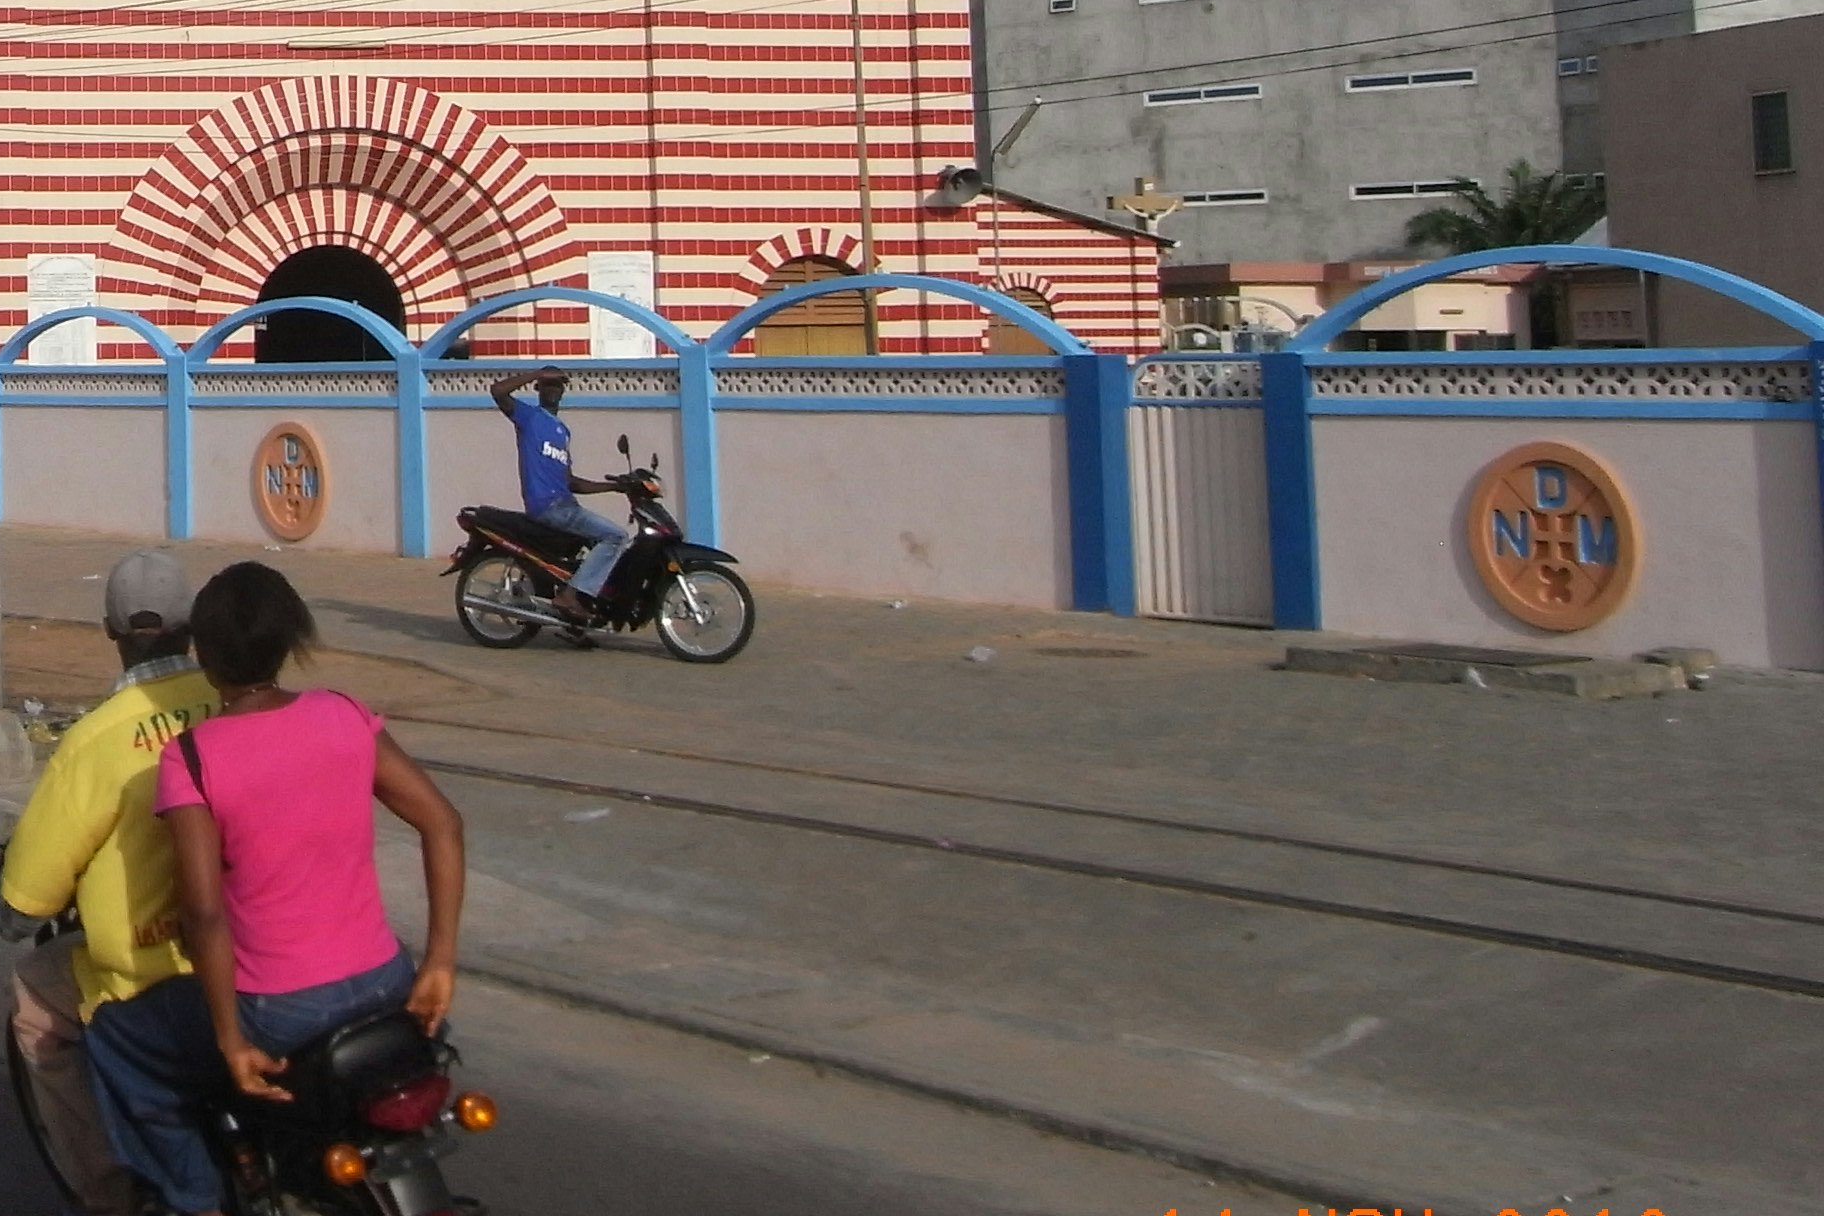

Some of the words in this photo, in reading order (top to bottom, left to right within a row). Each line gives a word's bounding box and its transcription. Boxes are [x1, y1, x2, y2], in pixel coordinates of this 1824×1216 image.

[1534, 466, 1568, 509] D
[1492, 510, 1530, 560] N
[1578, 515, 1617, 565] M
